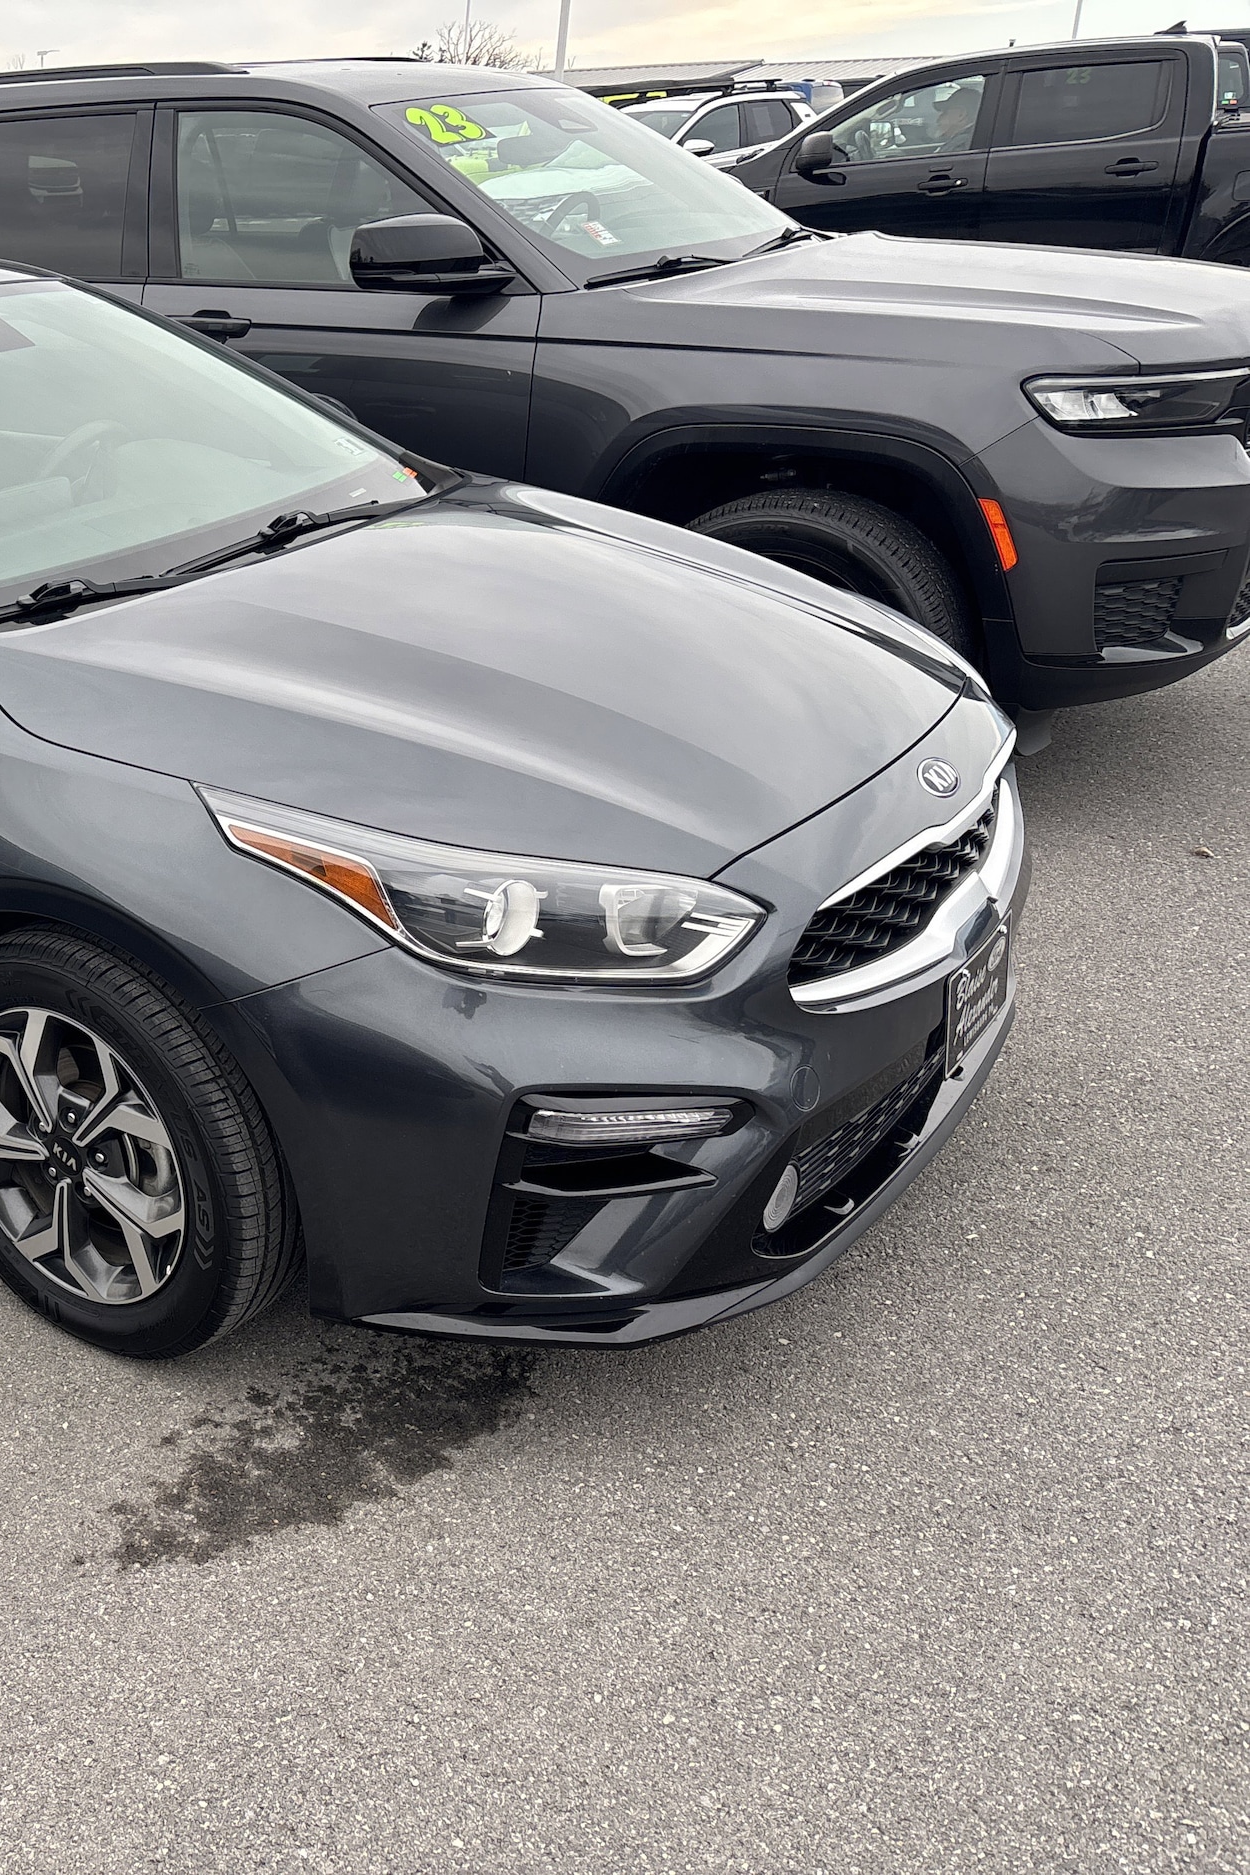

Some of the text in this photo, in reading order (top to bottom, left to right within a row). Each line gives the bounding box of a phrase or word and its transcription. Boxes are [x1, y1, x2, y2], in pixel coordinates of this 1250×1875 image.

[405, 104, 486, 144] 23
[922, 763, 957, 792] KIA
[956, 964, 987, 1011] Blaise
[953, 975, 999, 1047] Alexander
[53, 1142, 77, 1171] KIA
